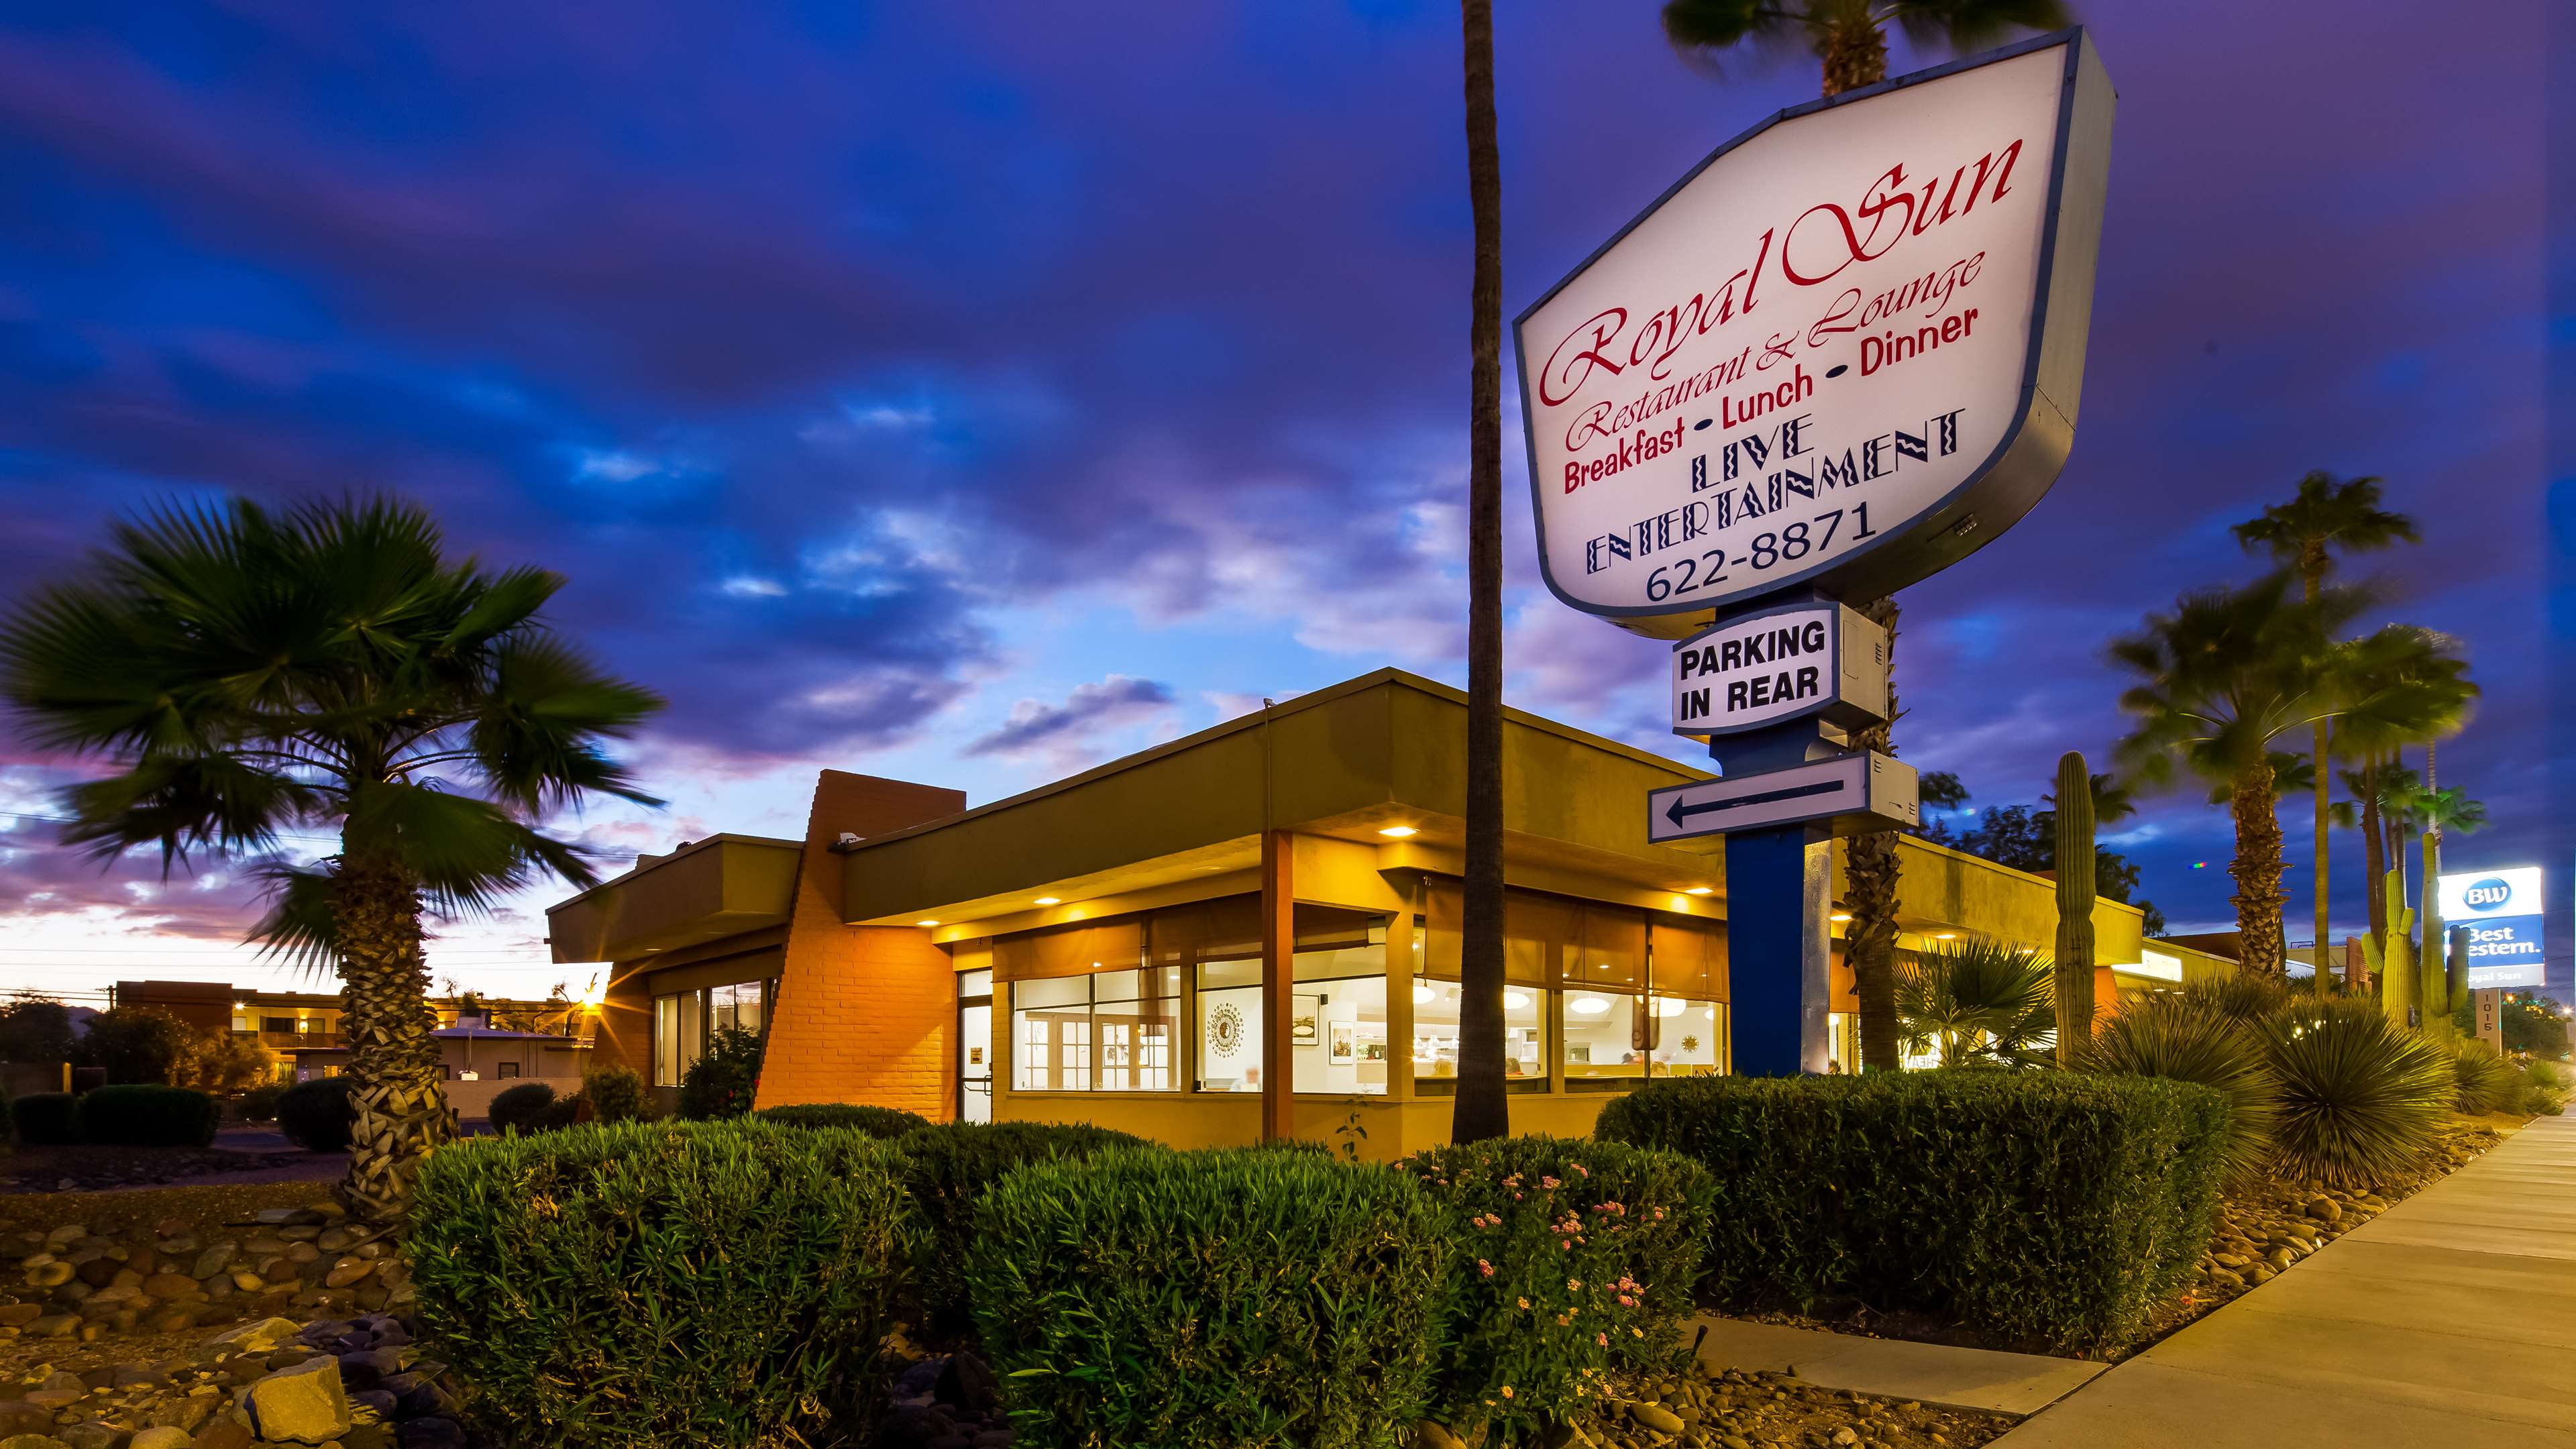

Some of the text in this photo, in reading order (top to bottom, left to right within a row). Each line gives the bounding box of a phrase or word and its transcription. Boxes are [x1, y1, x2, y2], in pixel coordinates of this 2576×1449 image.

[1539, 140, 2023, 408] Royal Sun
[1565, 251, 1986, 452] Restaurant & Lounge
[1564, 308, 1979, 494] Breakfast Lunch Dinner
[1585, 409, 1967, 576] ENTERTAINMENT
[1690, 413, 1815, 493] LIVE
[1646, 500, 1876, 602] 622-8871
[1680, 621, 1825, 681] PARKING
[1681, 666, 1819, 721] IN REAR
[2468, 886, 2508, 904] BW
[2468, 971, 2522, 983] oyal Sun
[2469, 942, 2541, 957] estern.
